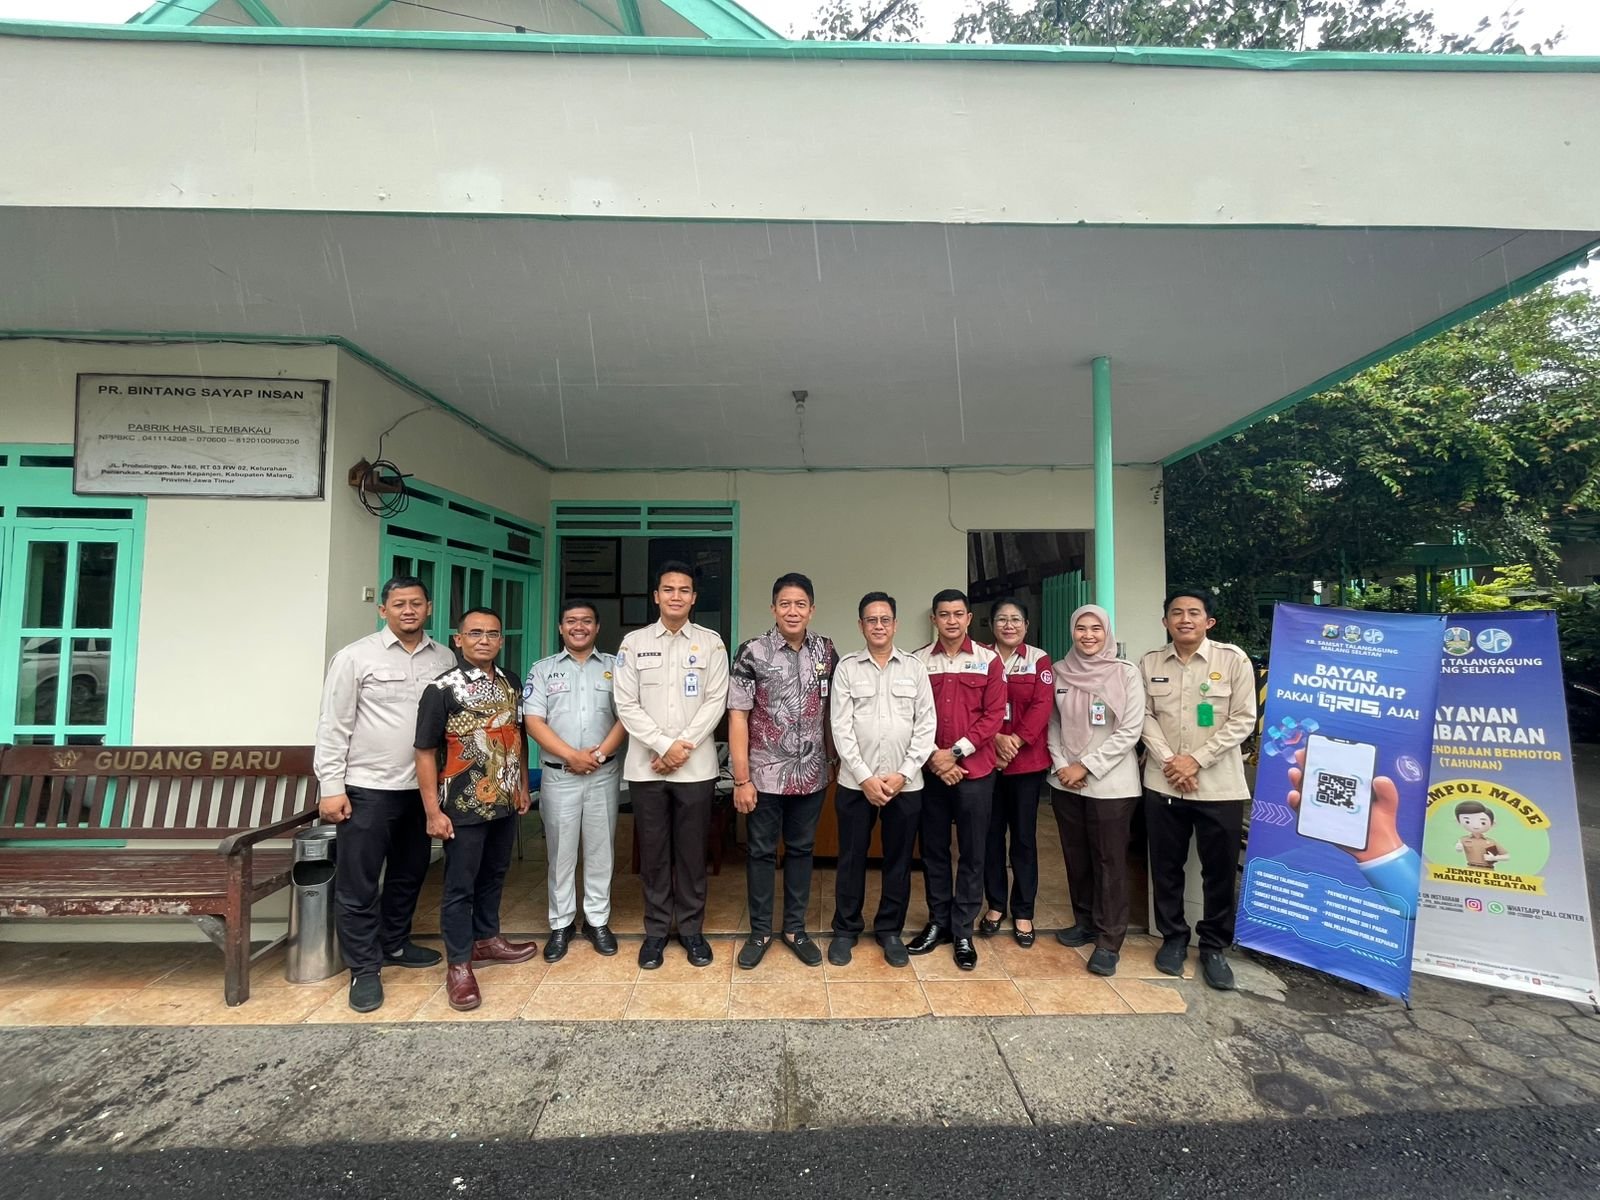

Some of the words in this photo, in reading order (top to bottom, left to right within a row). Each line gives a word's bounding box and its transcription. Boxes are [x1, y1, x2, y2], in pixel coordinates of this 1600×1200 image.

[98, 386, 122, 395] PR.
[128, 386, 196, 396] BINTANG
[201, 388, 252, 398] SAYAP
[258, 388, 304, 400] INSAN
[128, 424, 170, 432] PABRIK
[173, 424, 205, 432] HASIL
[210, 426, 272, 434] TEMBAKAU
[1321, 646, 1350, 654] MALANG
[1351, 649, 1382, 658] SELATAN
[1345, 643, 1398, 654] TALANGAGUNG
[1449, 658, 1542, 666] TALANGAGUNG
[1315, 663, 1378, 683] BAYAR
[1440, 666, 1460, 674] NG
[1462, 666, 1515, 674] SELATAN
[1293, 673, 1406, 700] NONTUNAI?
[1276, 688, 1313, 704] PAKAI
[1318, 692, 1380, 716] QRIS
[1387, 706, 1420, 720] AJA!
[1433, 724, 1546, 745] BAYARAN
[95, 751, 202, 770] GUDANG
[210, 751, 282, 770] BARU
[1494, 748, 1562, 761] BERMOTOR
[1440, 757, 1502, 771] (TAHUNAN)
[1488, 787, 1544, 824] MASE
[1433, 872, 1481, 884] MALANG
[1484, 878, 1537, 892] SELATAN
[1444, 868, 1490, 878] JEMPUT
[1493, 873, 1523, 882] BOLA
[1506, 904, 1540, 914] WHATSAPP
[1542, 910, 1558, 918] CALL
[1558, 912, 1584, 922] CENTER
